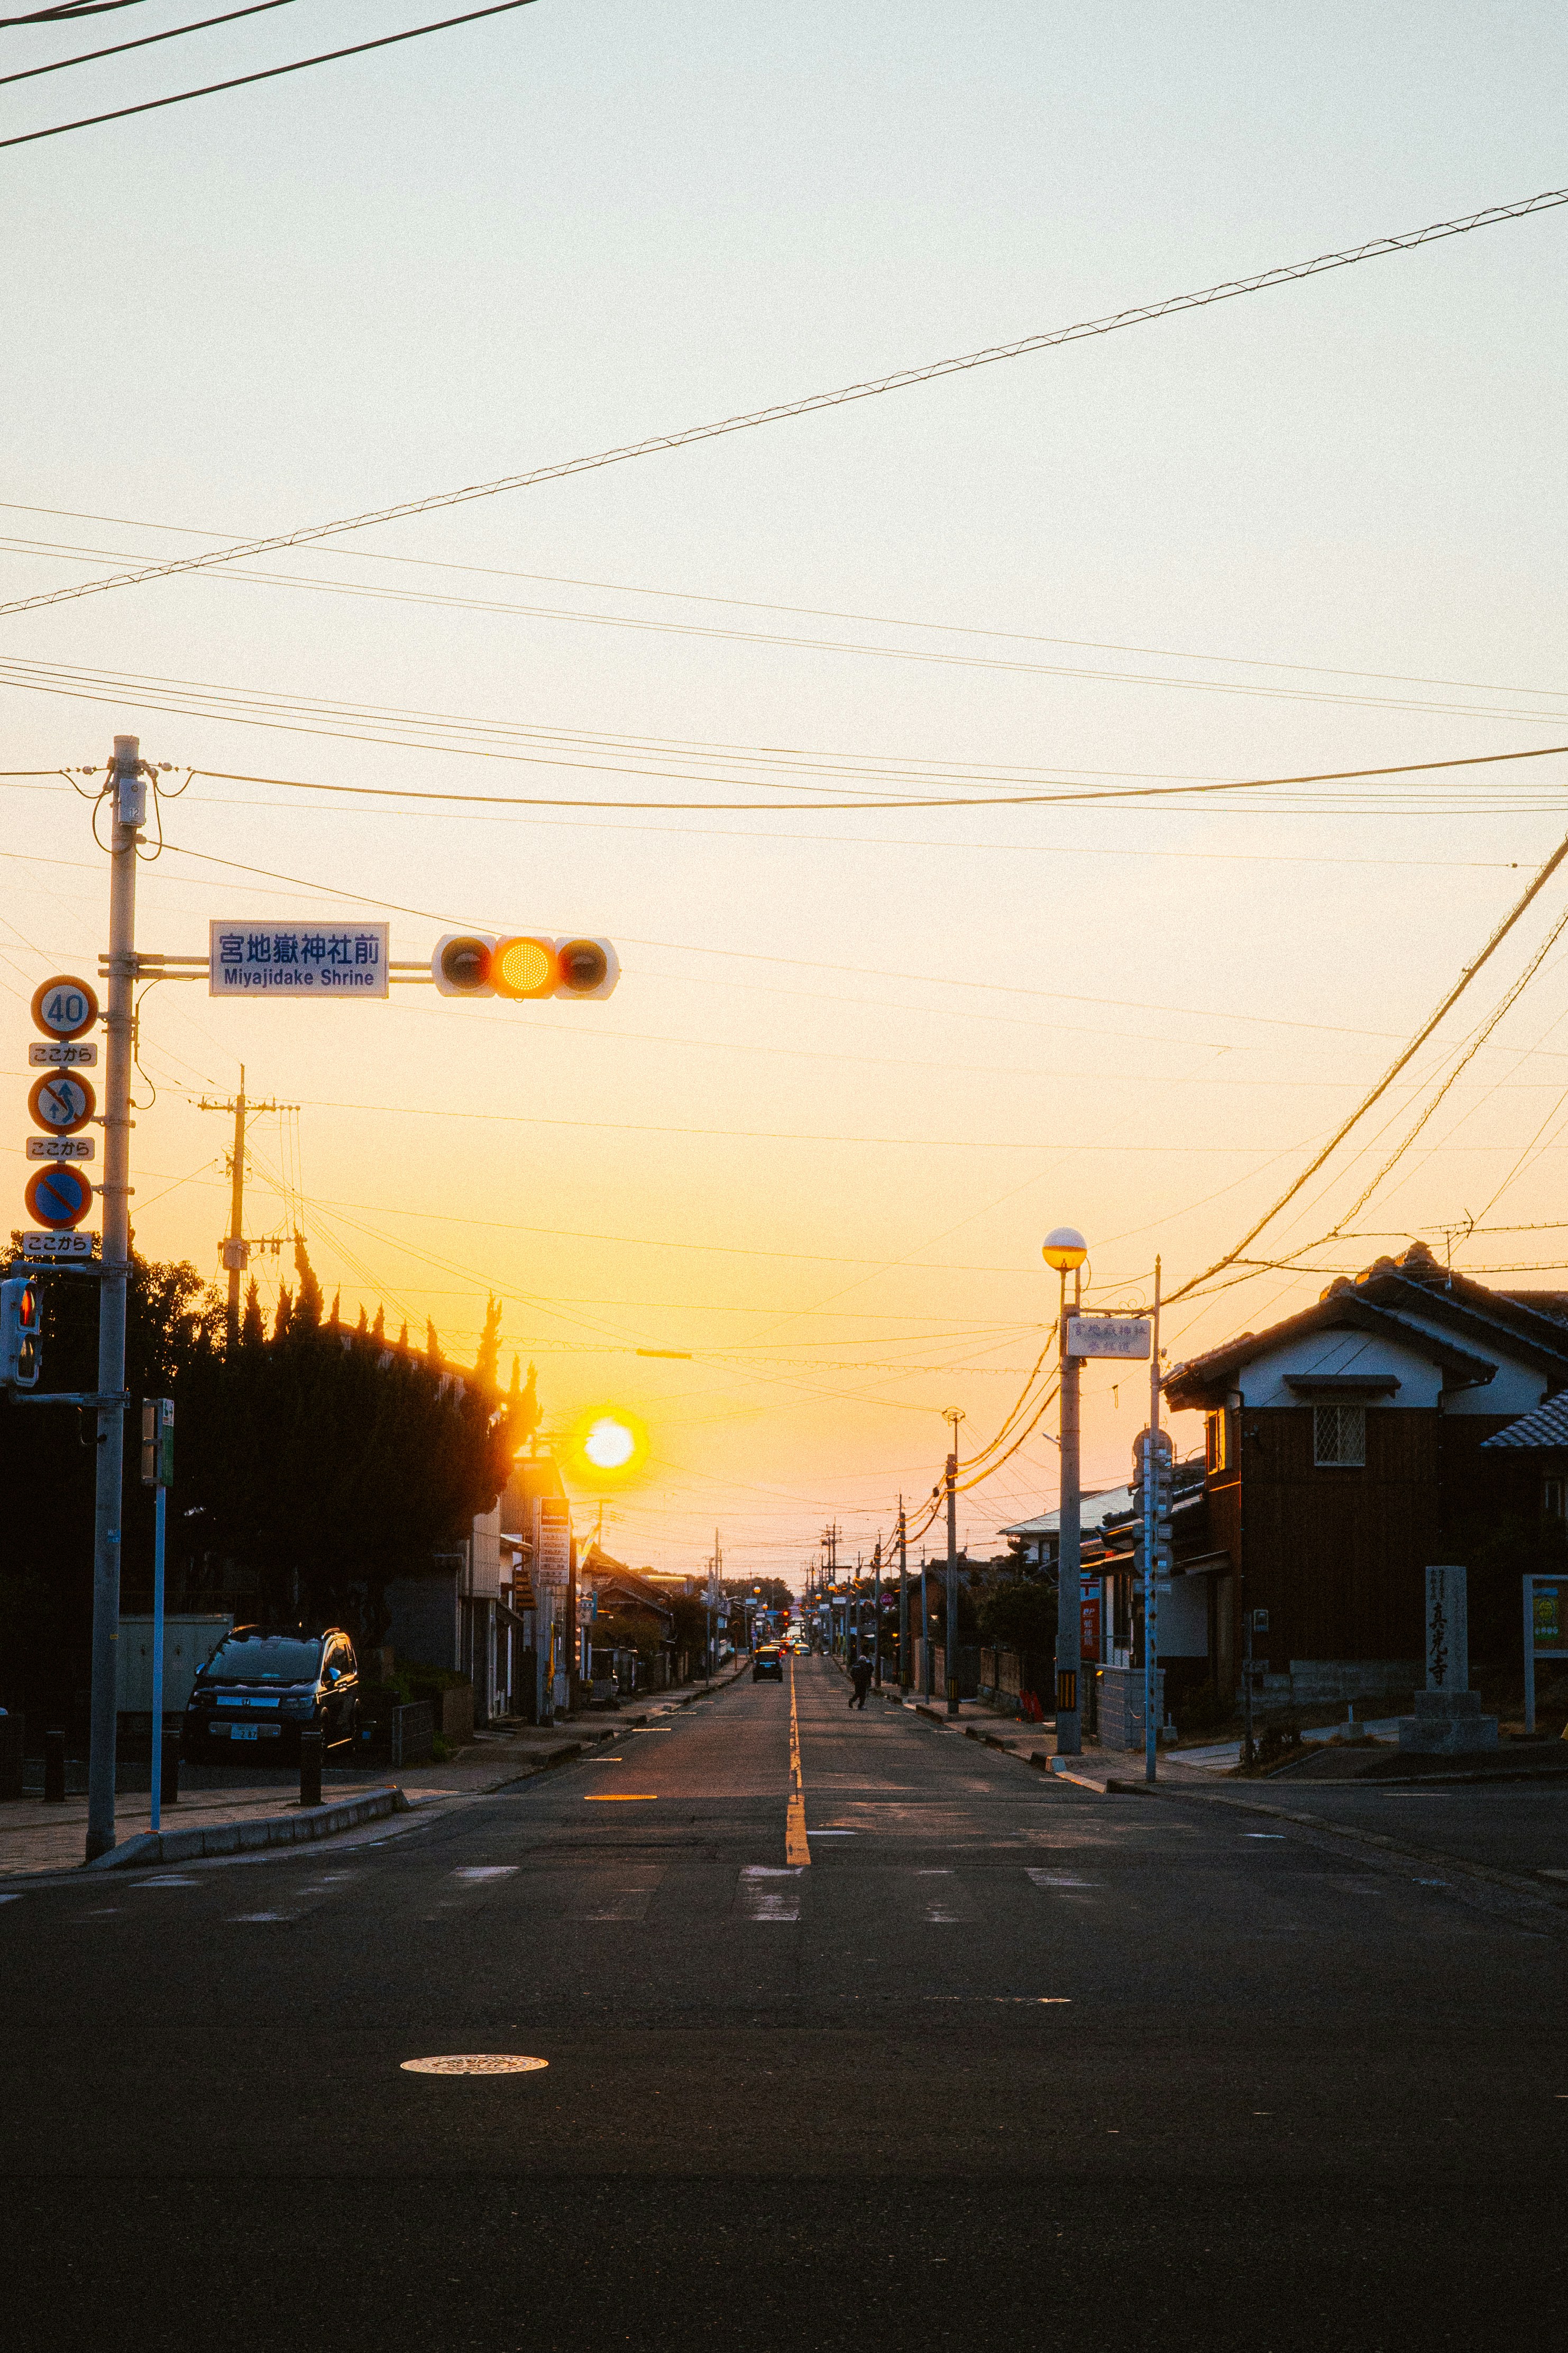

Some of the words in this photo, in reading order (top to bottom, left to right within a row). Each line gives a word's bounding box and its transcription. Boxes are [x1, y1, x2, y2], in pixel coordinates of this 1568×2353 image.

[219, 933, 380, 965] 宮地嶽神社前
[224, 968, 314, 988] Miyajidake
[320, 969, 374, 986] Shrine
[48, 994, 83, 1023] 40
[34, 1047, 92, 1062] ここから
[31, 1142, 90, 1156] ここから
[28, 1236, 87, 1251] ここから
